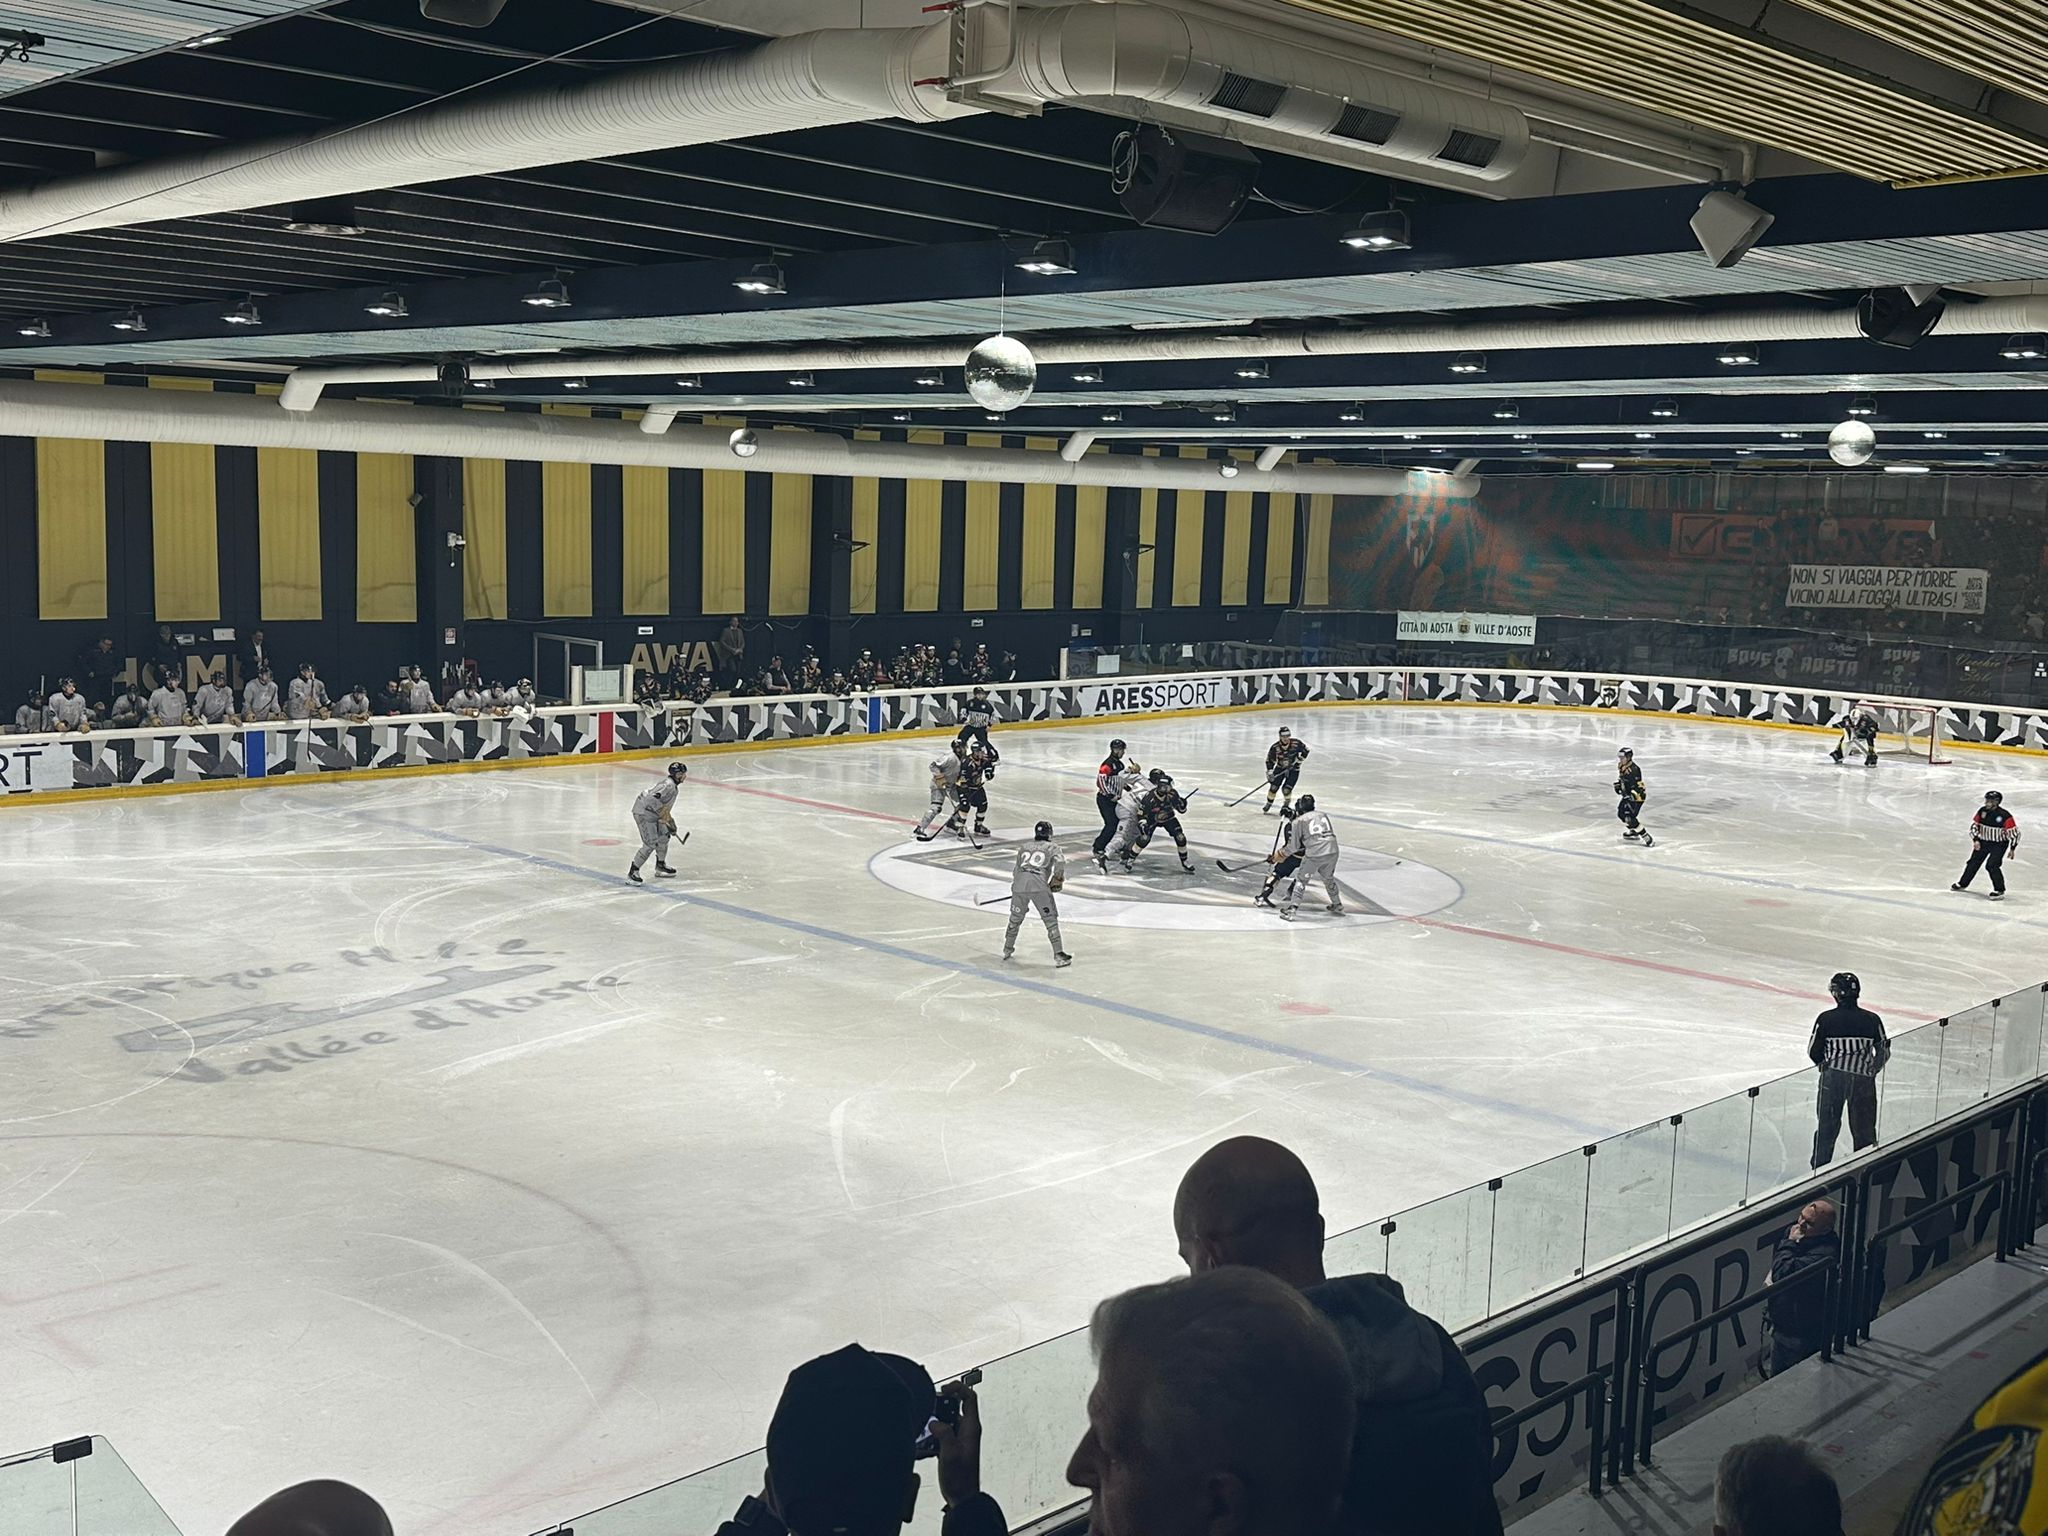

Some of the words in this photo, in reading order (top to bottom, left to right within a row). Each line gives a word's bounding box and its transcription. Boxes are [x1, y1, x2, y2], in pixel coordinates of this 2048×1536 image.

[1792, 568, 1817, 585] NON
[1821, 569, 1835, 585] SI
[1838, 569, 1882, 586] VIAGGIA
[1886, 570, 1911, 587] PER
[1913, 571, 1957, 588] MORIRE
[1789, 589, 1824, 605] VICINO
[1824, 590, 1856, 606] ALLA
[1857, 590, 1901, 606] FOGGIA
[1906, 592, 1958, 608] ULTRAS!
[1400, 620, 1418, 633] CITTÀ
[1420, 622, 1428, 633] DI
[1430, 622, 1454, 634] AOSTA
[1474, 624, 1495, 635] VILLE
[1498, 625, 1532, 637] D'AOSTE
[1800, 657, 1858, 677] AOSTA
[1095, 682, 1220, 712] ARESSPORT
[1308, 817, 1331, 836] 61
[1020, 851, 1046, 868] 20
